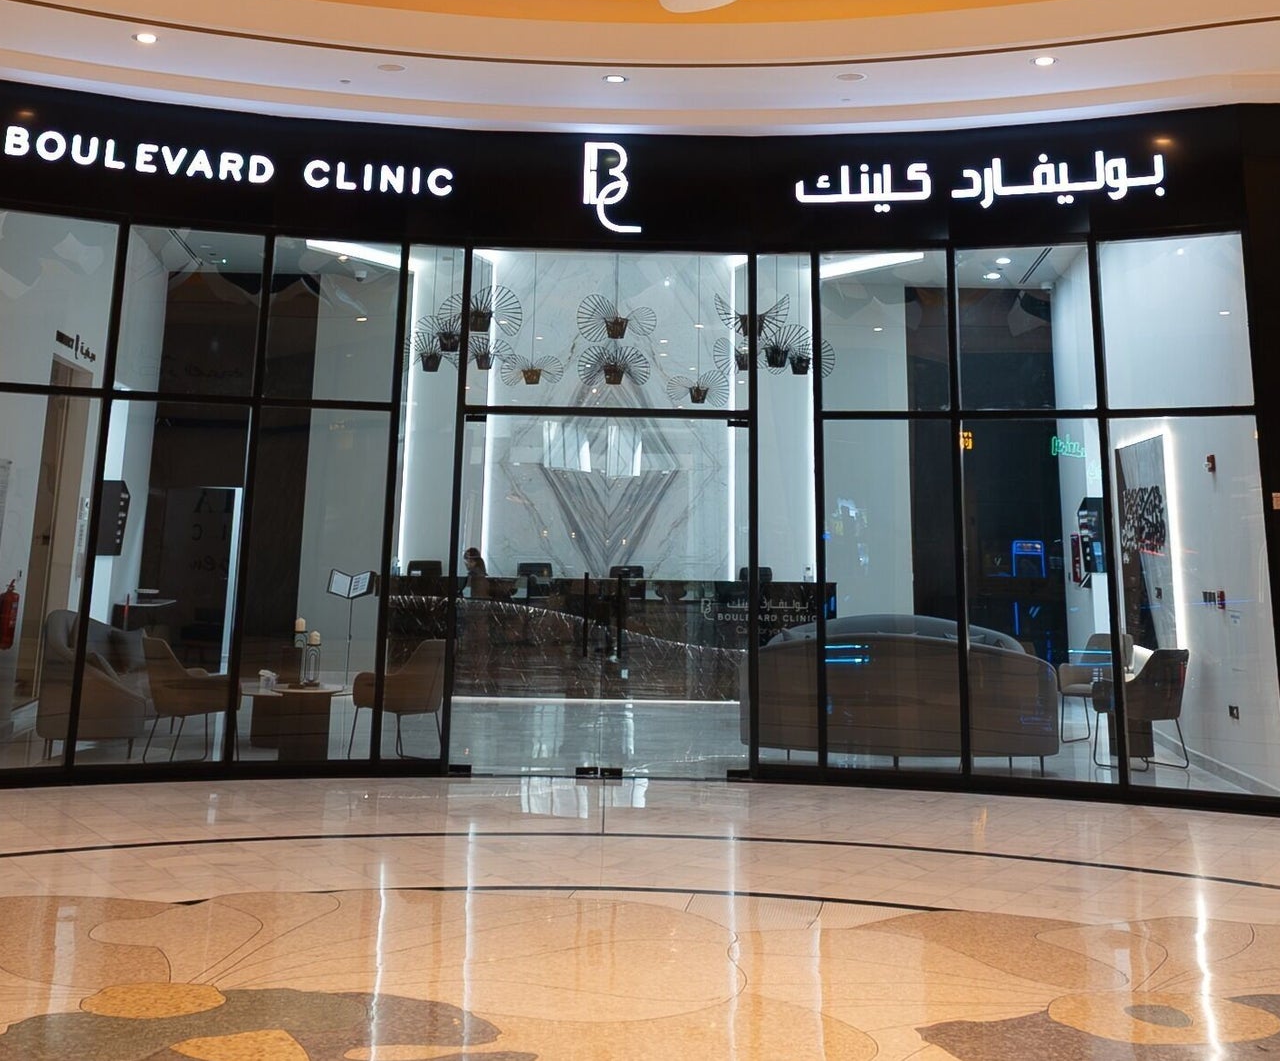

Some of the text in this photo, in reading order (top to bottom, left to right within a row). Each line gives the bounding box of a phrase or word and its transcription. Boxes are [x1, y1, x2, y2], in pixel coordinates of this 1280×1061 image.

[4, 125, 454, 197] BOULEVARD CLINIC
[794, 149, 1166, 214] بوليفارد كلينك
[718, 613, 778, 622] BOULEARD
